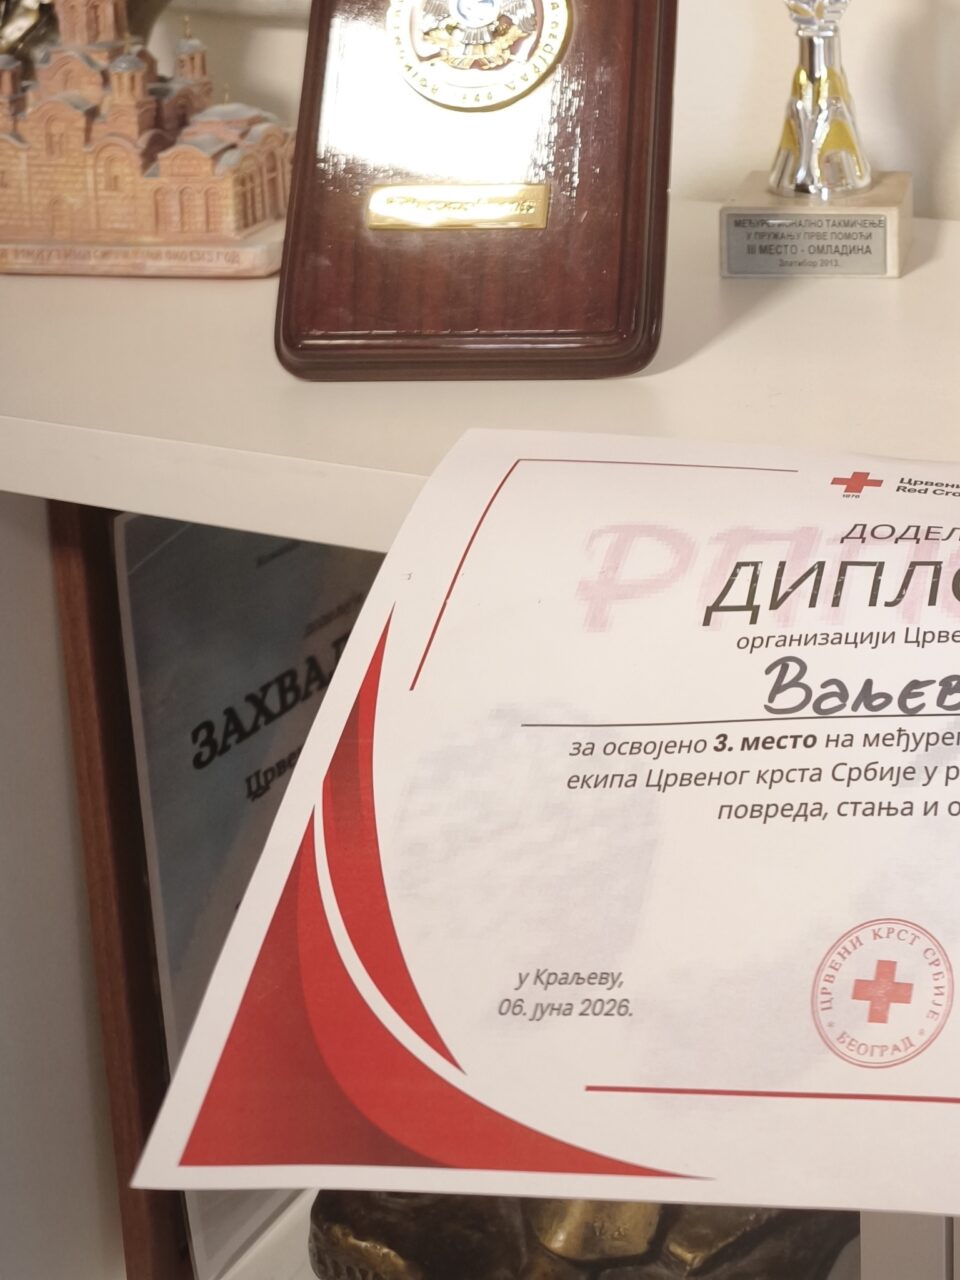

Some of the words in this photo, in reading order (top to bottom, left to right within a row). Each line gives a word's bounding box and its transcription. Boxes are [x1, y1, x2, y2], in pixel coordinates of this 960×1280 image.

[827, 220, 885, 229] ТАКМИЧЕЊЕ
[759, 245, 798, 255] МЕСТО
[808, 245, 872, 256] ОМЛАДИНА
[896, 485, 928, 495] Red
[736, 628, 896, 654] организацији
[569, 740, 595, 756] за
[602, 738, 708, 761] освојено
[713, 734, 733, 752] 3.
[740, 733, 817, 752] место
[825, 732, 854, 748] на
[244, 745, 304, 802] Црве
[566, 771, 637, 789] екипа
[645, 768, 749, 793] Црвеног
[756, 767, 823, 789] крста
[831, 761, 916, 787] Србије
[922, 765, 938, 786] у
[718, 801, 828, 824] повреда,
[836, 799, 914, 817] стања
[923, 801, 938, 816] и
[514, 972, 530, 991] у
[533, 968, 624, 991] Краљеву,
[820, 935, 864, 1011] ЦРВЕНИ
[872, 927, 921, 946] КРСТ
[923, 947, 946, 1021] СРБИЈЕ
[498, 998, 527, 1016] 06.
[528, 1002, 574, 1021] јуна
[578, 998, 633, 1017] 2026.
[836, 1031, 915, 1057] БЕОГРАД
